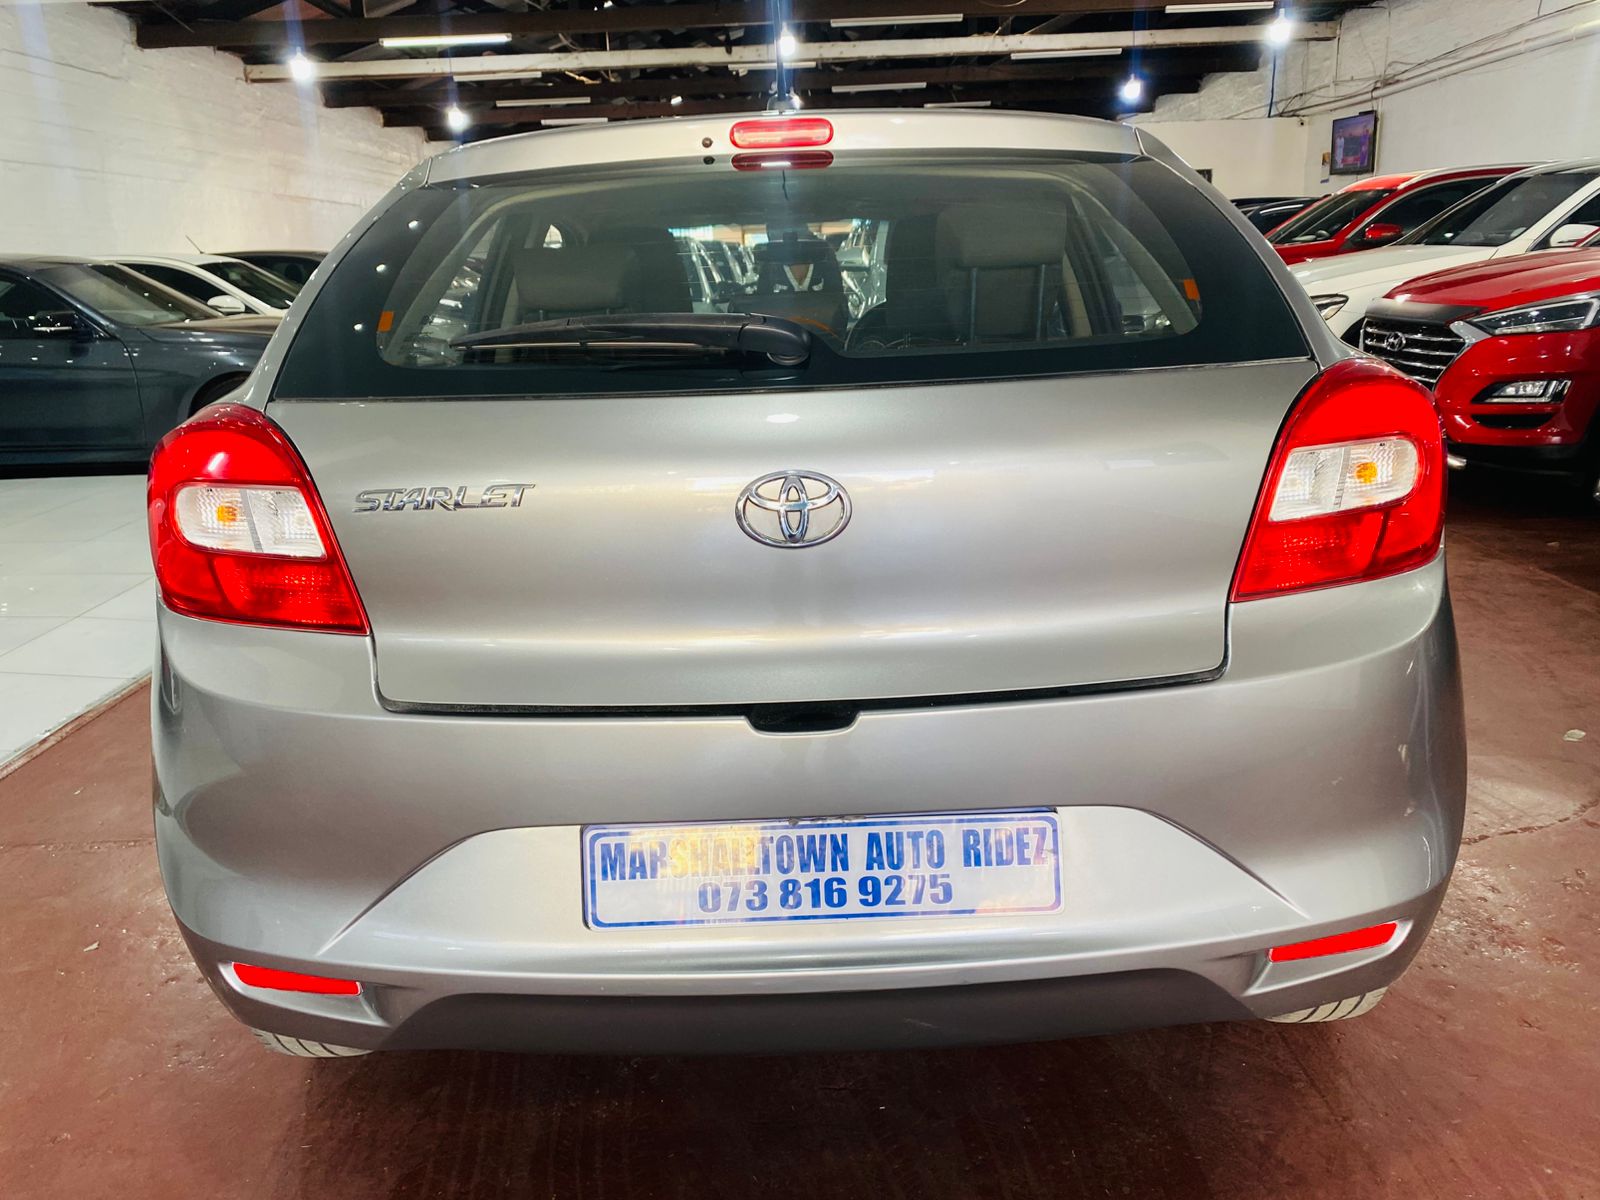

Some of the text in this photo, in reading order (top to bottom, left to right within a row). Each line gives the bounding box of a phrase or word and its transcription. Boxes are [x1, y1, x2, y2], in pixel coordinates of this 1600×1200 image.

[352, 484, 536, 513] STARLET
[865, 829, 945, 872] AUTO
[962, 827, 1048, 868] RIDEZ
[698, 873, 953, 913] 073 816 9275
